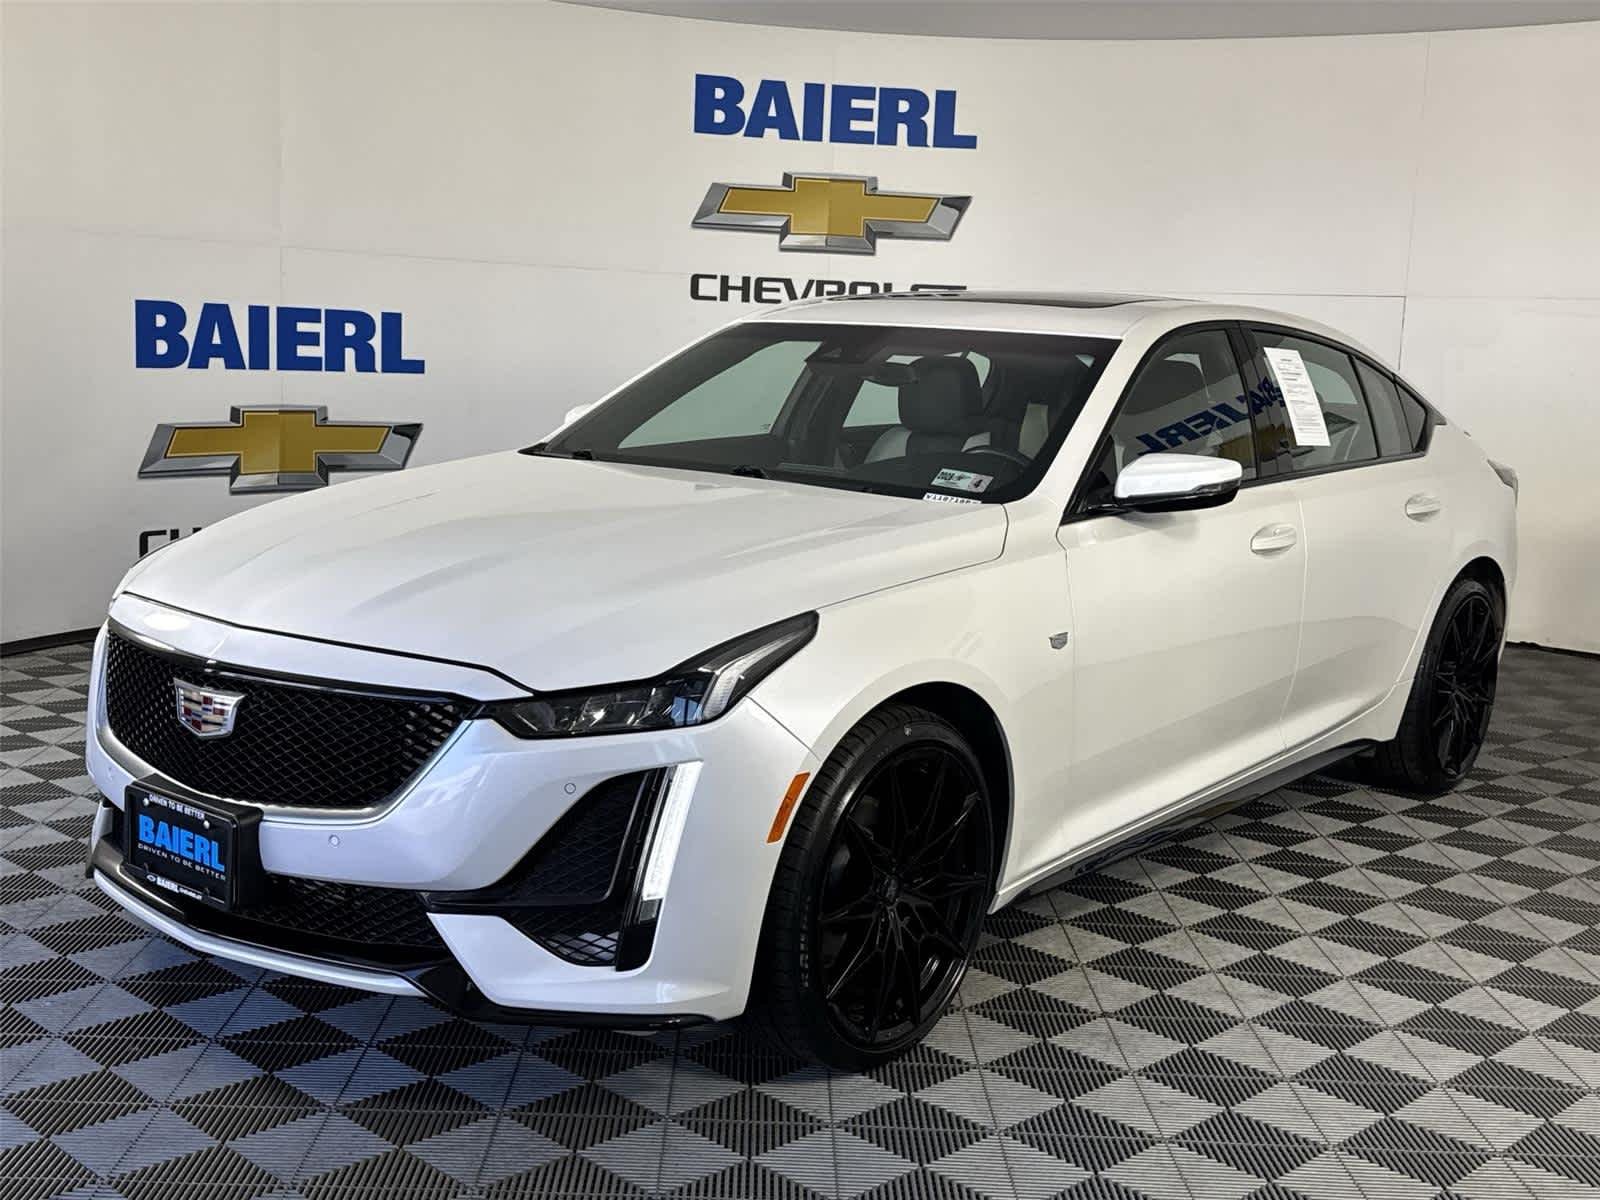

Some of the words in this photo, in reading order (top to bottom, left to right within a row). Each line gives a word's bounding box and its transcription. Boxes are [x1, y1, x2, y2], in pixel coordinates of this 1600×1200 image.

[694, 73, 977, 149] BAIERL
[690, 273, 967, 304] CHEVR
[135, 299, 425, 374] BAIERL
[138, 814, 225, 873] BAIERL
[138, 843, 168, 859] DRIVEN
[170, 855, 181, 863] TO
[183, 859, 193, 869] BE
[195, 865, 226, 881] BETTER
